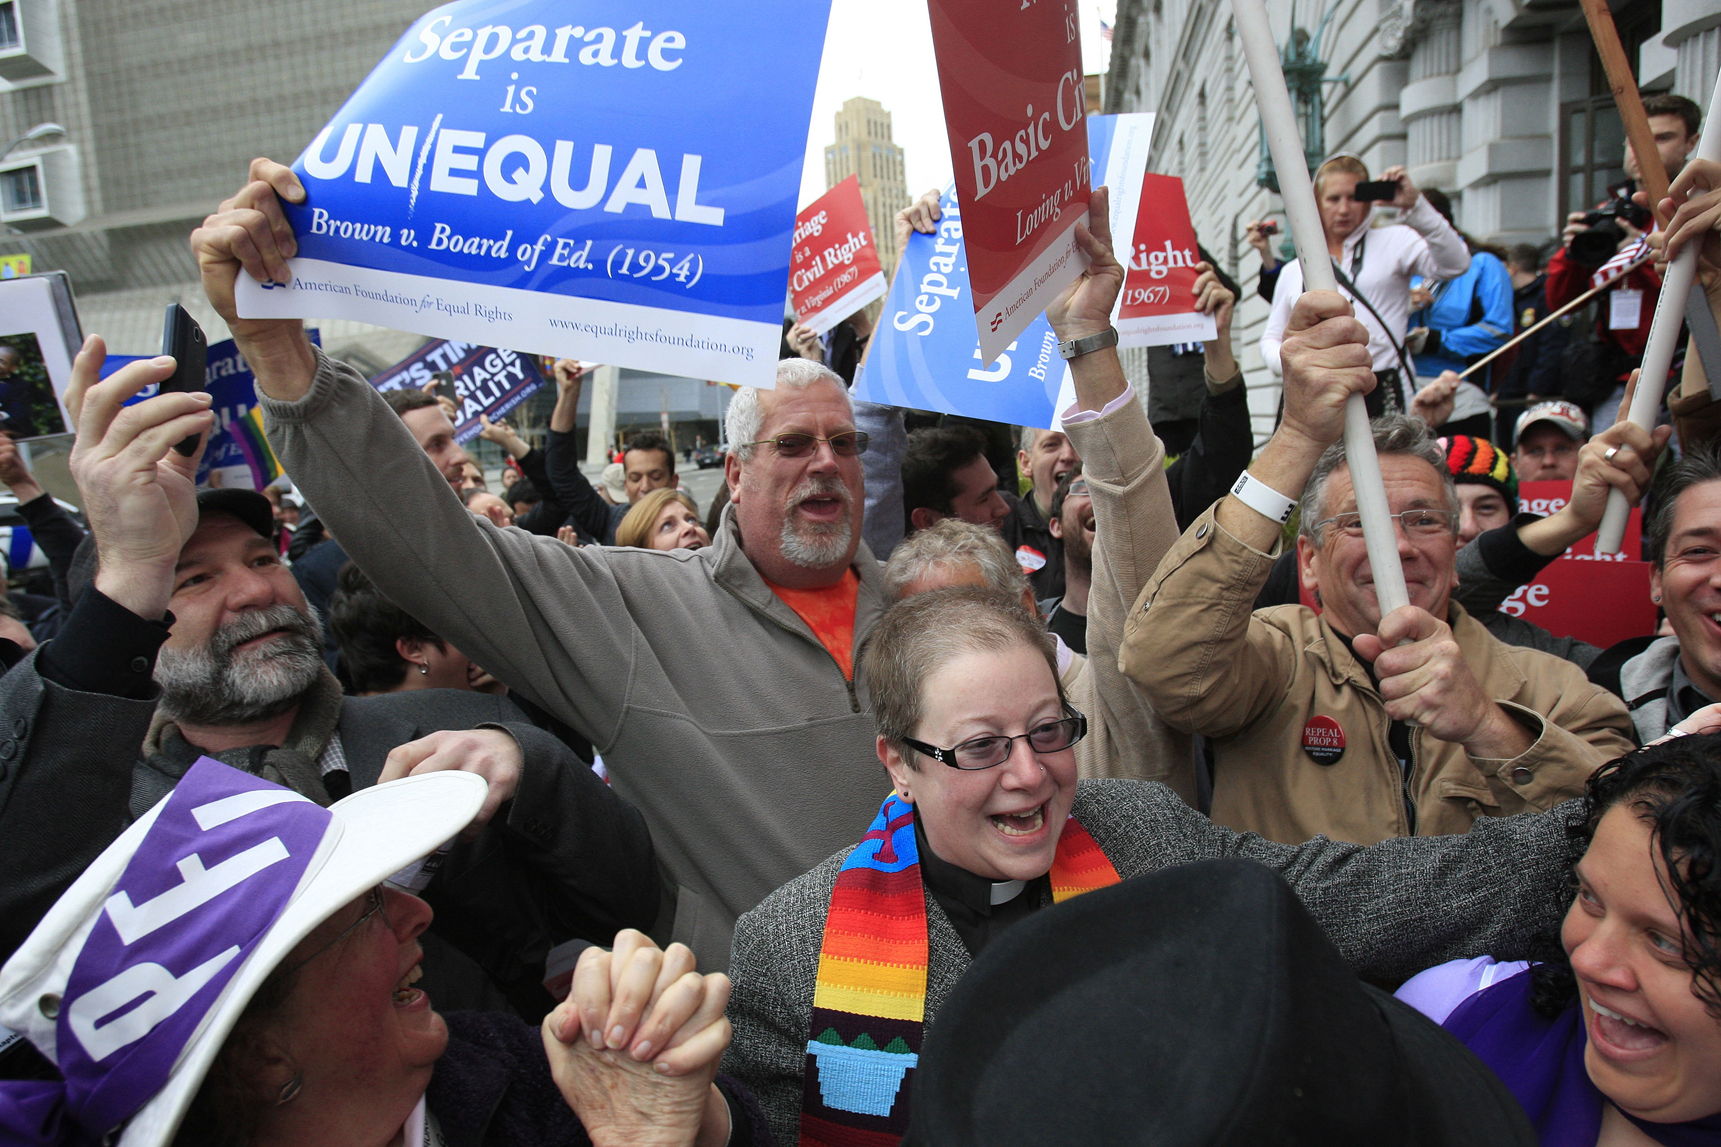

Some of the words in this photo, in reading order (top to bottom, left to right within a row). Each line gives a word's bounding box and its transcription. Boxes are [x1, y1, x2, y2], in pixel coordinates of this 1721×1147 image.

[404, 15, 686, 81] Separate
[499, 72, 537, 114] is
[967, 103, 1052, 202] Basic
[1015, 193, 1061, 246] Loving
[1063, 179, 1073, 202] v.
[310, 207, 391, 244] Brown
[400, 229, 418, 247] v.
[428, 223, 513, 258] Board
[516, 234, 551, 272] of
[548, 237, 594, 270] Ed.
[606, 244, 703, 289] (1954)
[793, 255, 825, 291] Civil
[823, 230, 868, 270] Right
[292, 276, 351, 295] American
[353, 284, 418, 307] Foundation
[415, 294, 435, 313] for
[436, 298, 470, 316] Equal
[474, 303, 513, 323] Rights
[833, 265, 858, 292] (1967)
[1003, 285, 1034, 320] American
[1033, 256, 1066, 293] Foundation
[548, 317, 755, 360] www.equalrightsfoundation.org
[1028, 330, 1056, 382] Brown
[1305, 727, 1341, 738] REPEAL
[1308, 736, 1332, 746] PROP
[1332, 737, 1339, 746] 8
